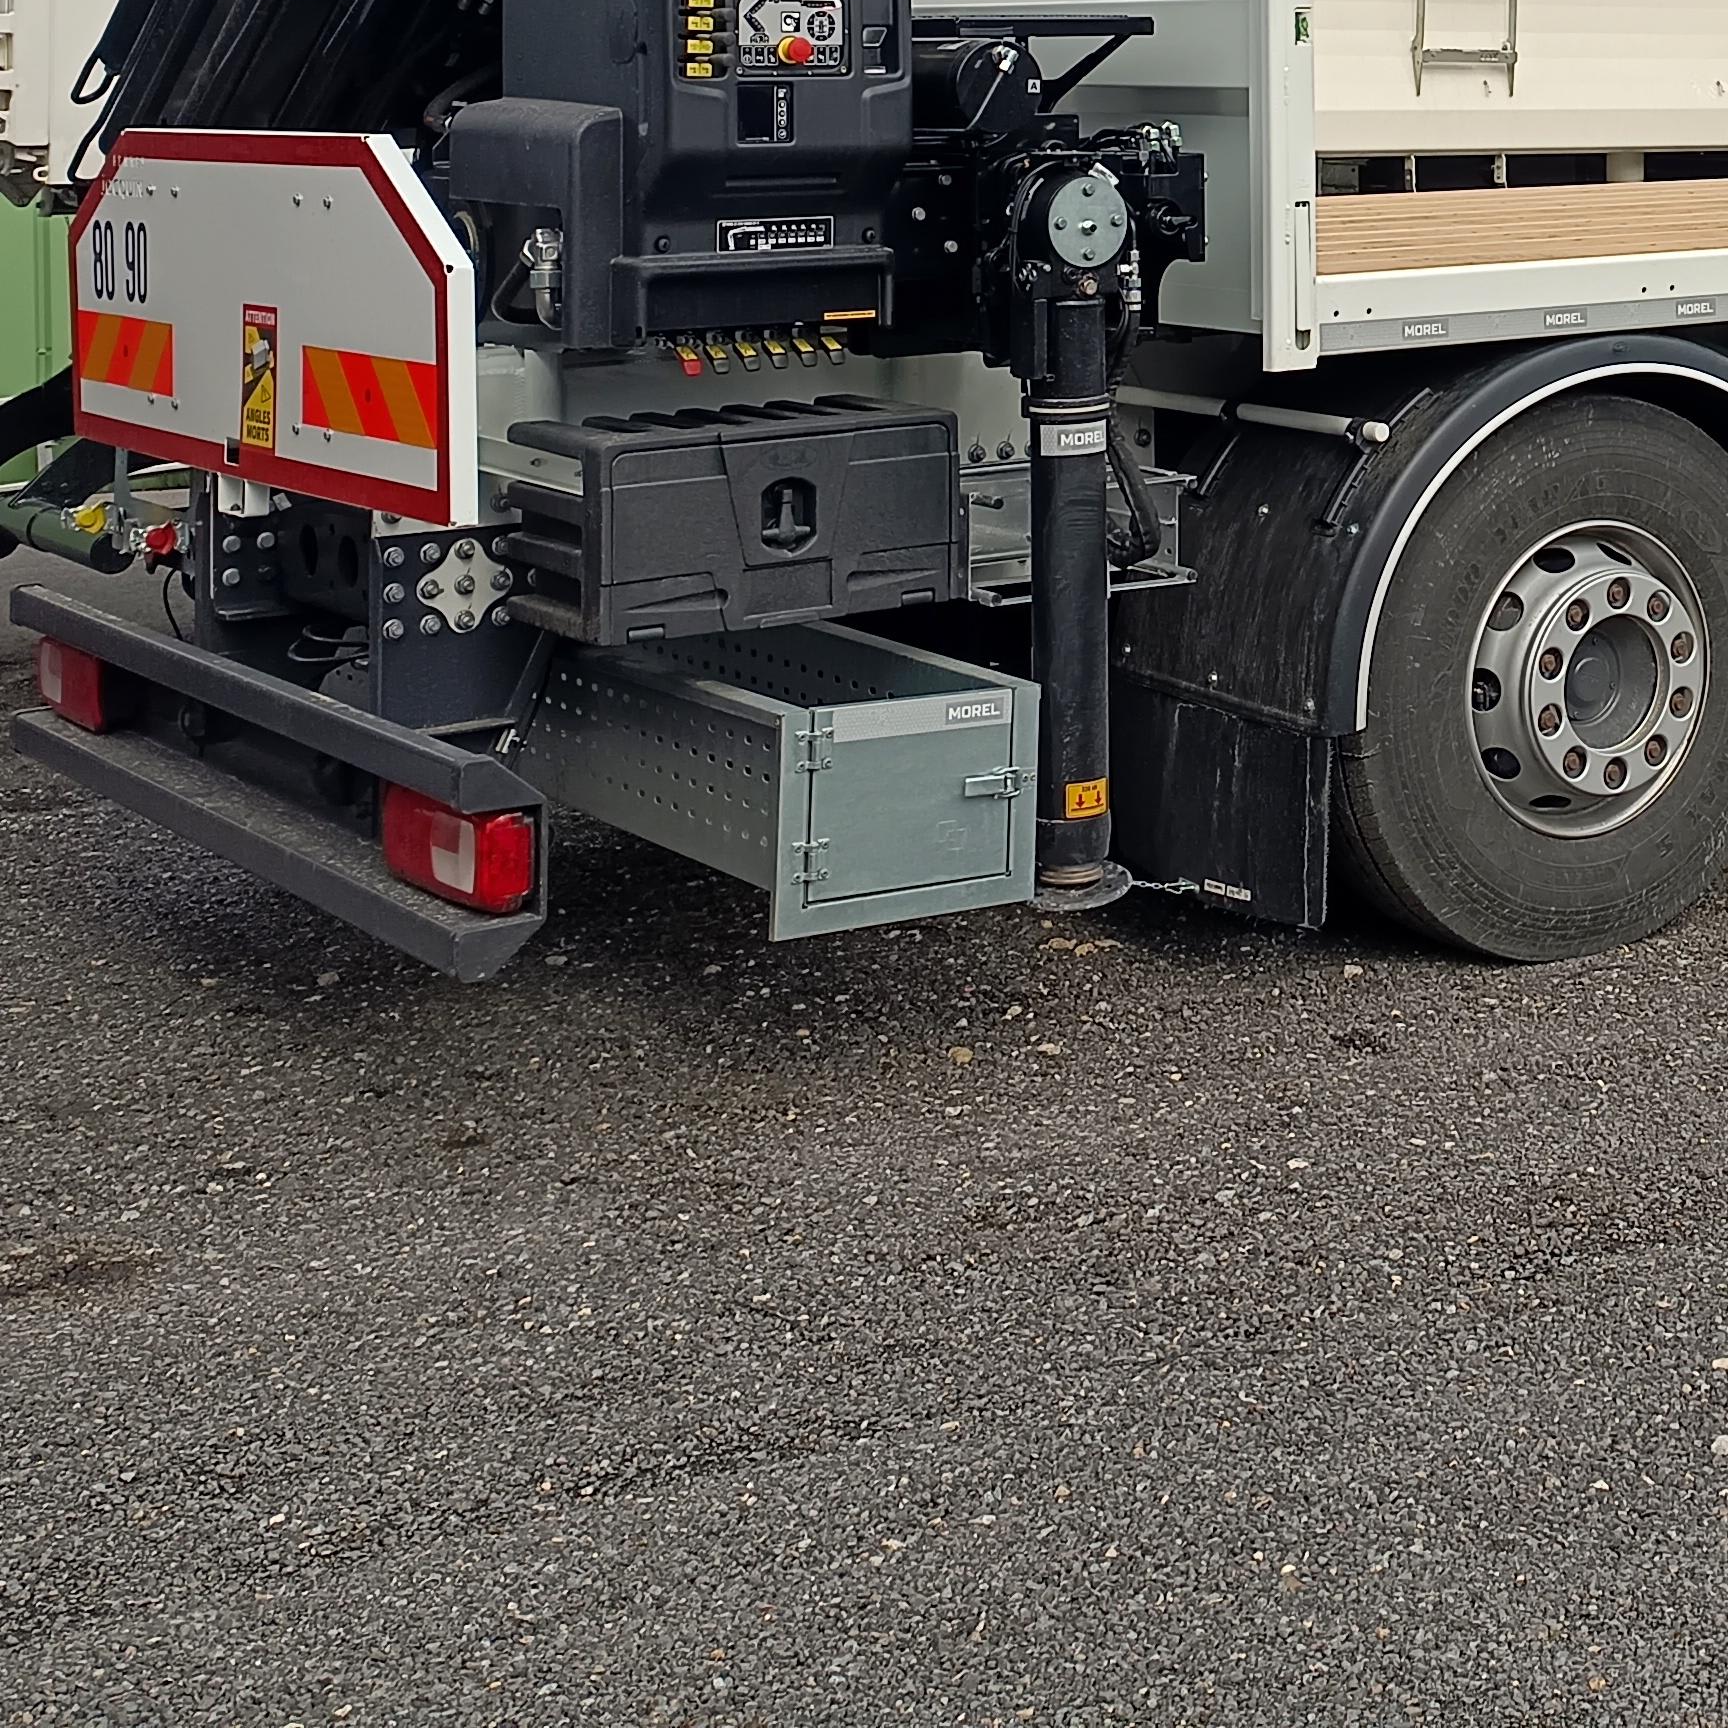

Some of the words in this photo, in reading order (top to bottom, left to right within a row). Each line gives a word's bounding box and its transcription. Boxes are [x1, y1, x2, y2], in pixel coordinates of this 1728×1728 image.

[93, 220, 115, 301] 80
[125, 221, 148, 304] 90
[1677, 302, 1714, 316] MOREL
[1545, 312, 1585, 326] MOREL
[1404, 323, 1447, 337] MOREL
[246, 407, 271, 425] ANGLES
[246, 423, 270, 442] MORTS
[948, 702, 1001, 720] MOREL
